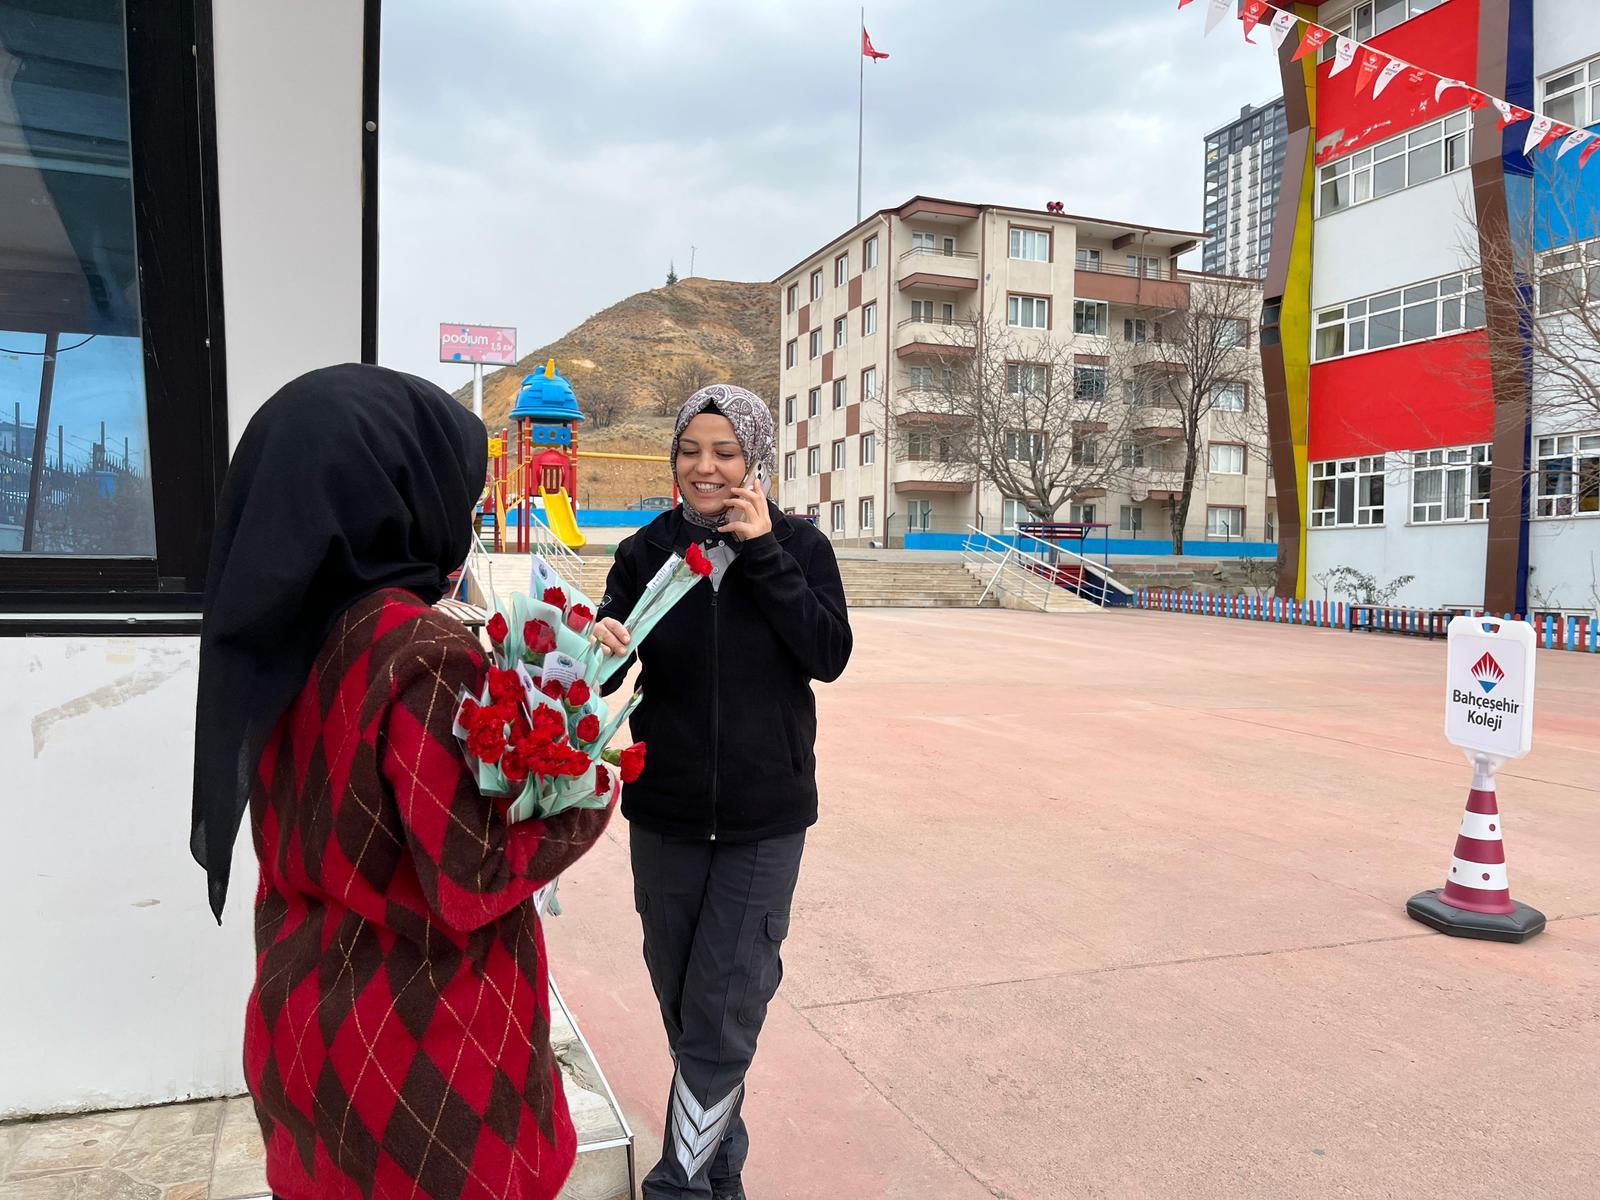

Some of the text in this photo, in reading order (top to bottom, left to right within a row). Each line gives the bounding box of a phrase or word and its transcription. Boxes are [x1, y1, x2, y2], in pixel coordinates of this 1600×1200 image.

[442, 328, 488, 345] podium
[1453, 689, 1519, 714] Bahçeşehir
[1467, 710, 1503, 732] Koleji
